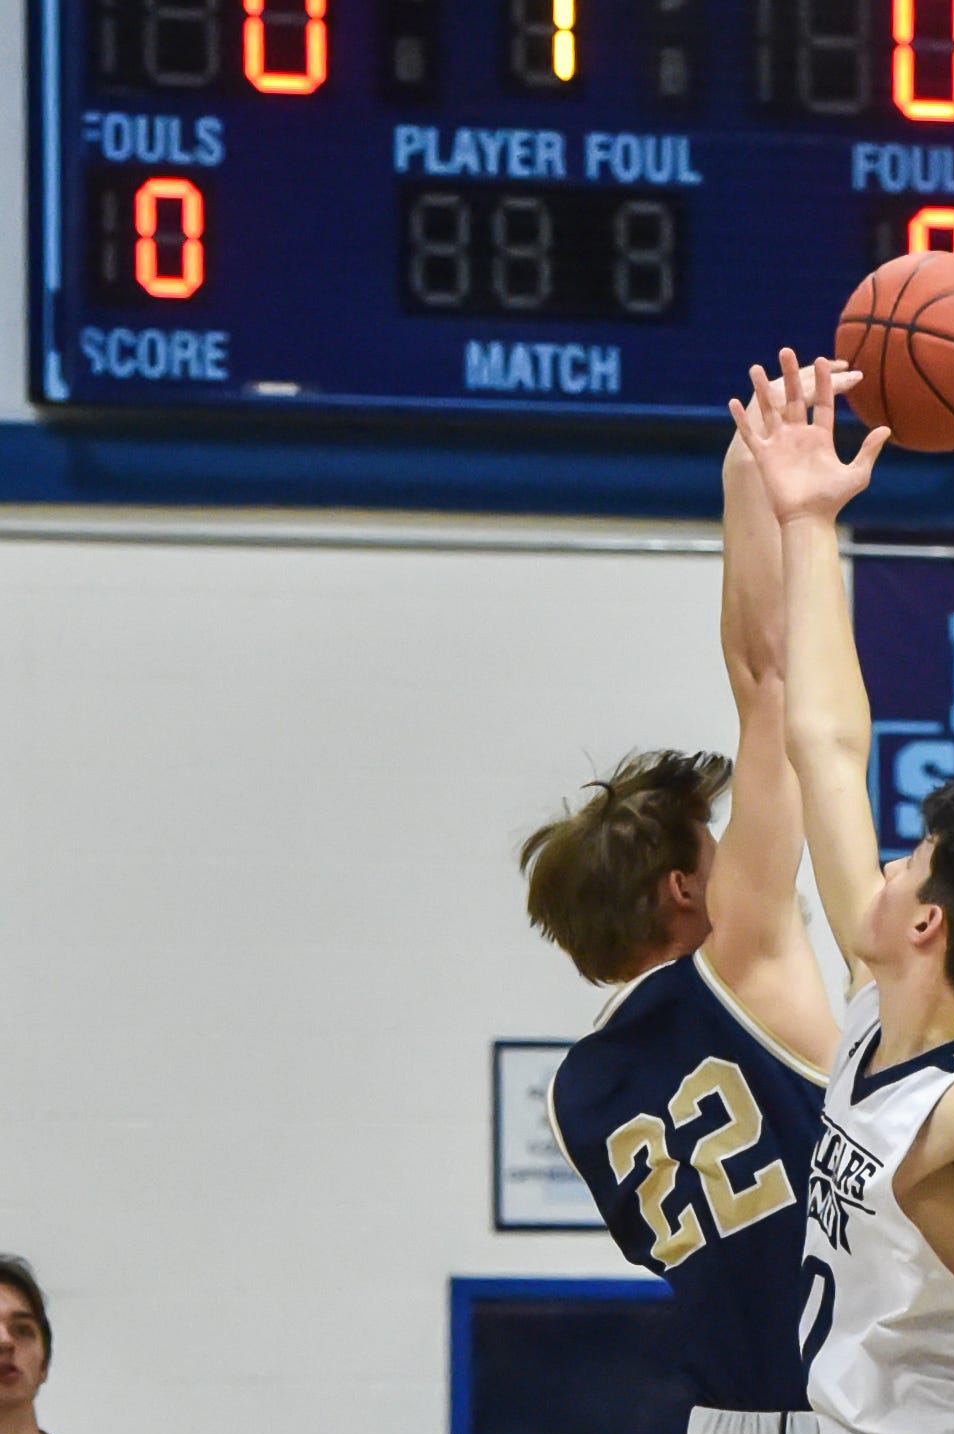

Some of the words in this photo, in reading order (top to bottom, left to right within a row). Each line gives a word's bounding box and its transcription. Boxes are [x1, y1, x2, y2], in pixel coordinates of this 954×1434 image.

[394, 124, 566, 179] PLAYER
[584, 132, 703, 184] FOUL
[134, 176, 205, 299] 0
[79, 327, 231, 381] SCORE
[464, 341, 621, 393] MATCH
[606, 1056, 797, 1271] 22
